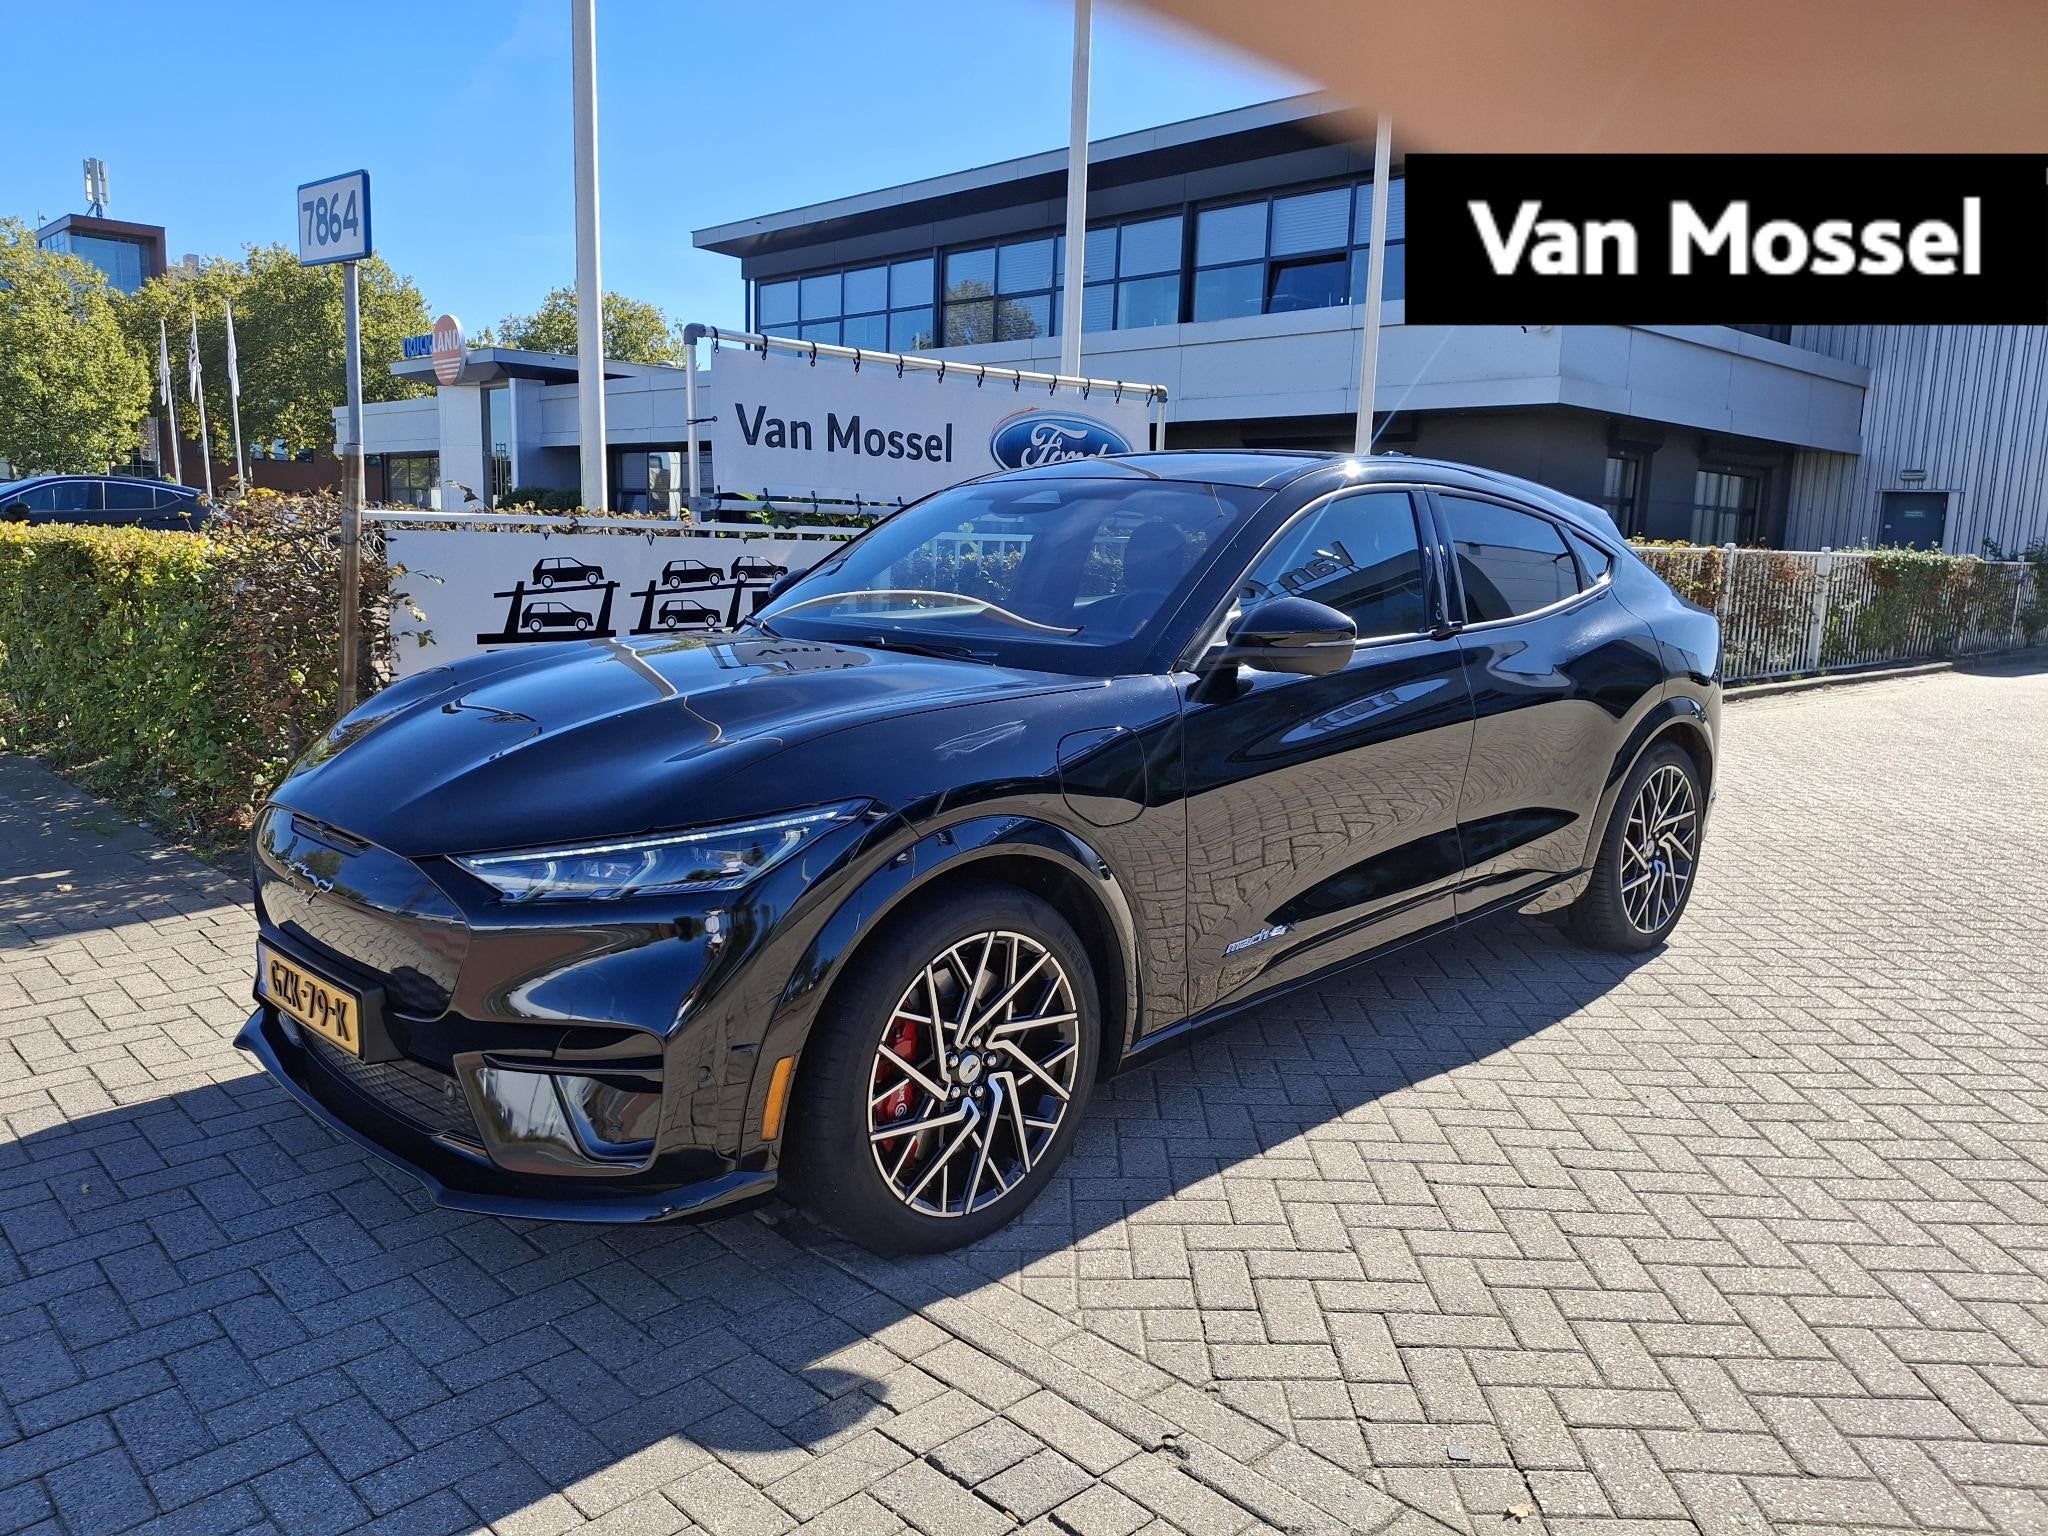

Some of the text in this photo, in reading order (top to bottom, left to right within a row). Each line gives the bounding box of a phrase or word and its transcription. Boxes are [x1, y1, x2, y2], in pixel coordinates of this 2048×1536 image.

[302, 189, 358, 246] 7864
[734, 402, 953, 463] Van Mossel
[271, 959, 351, 1042] GZK-79-K
